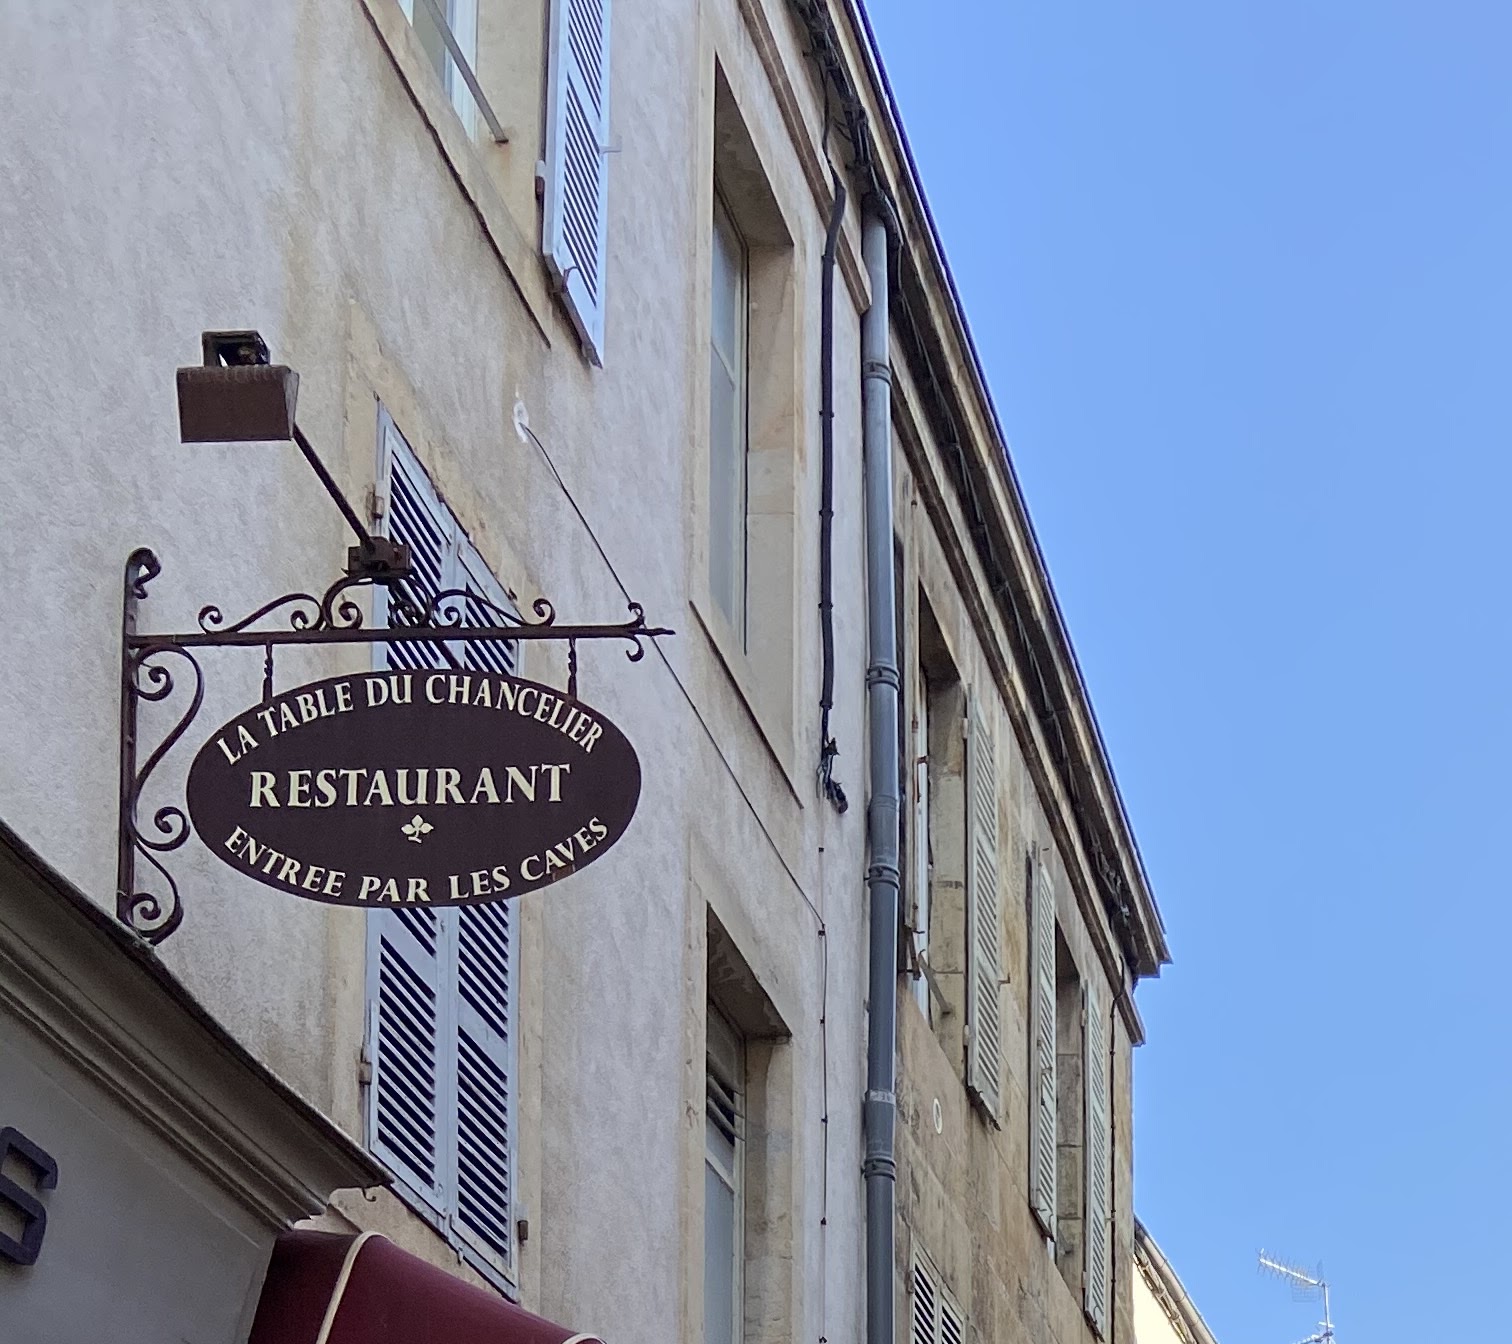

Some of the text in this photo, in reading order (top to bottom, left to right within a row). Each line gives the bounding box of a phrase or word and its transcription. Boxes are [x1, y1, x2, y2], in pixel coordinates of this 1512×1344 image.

[217, 674, 603, 765] LA TABLE DU CHANCELIER
[250, 764, 570, 808] RESTAURANT
[225, 817, 609, 902] ENTREE PAR LES CAVES
